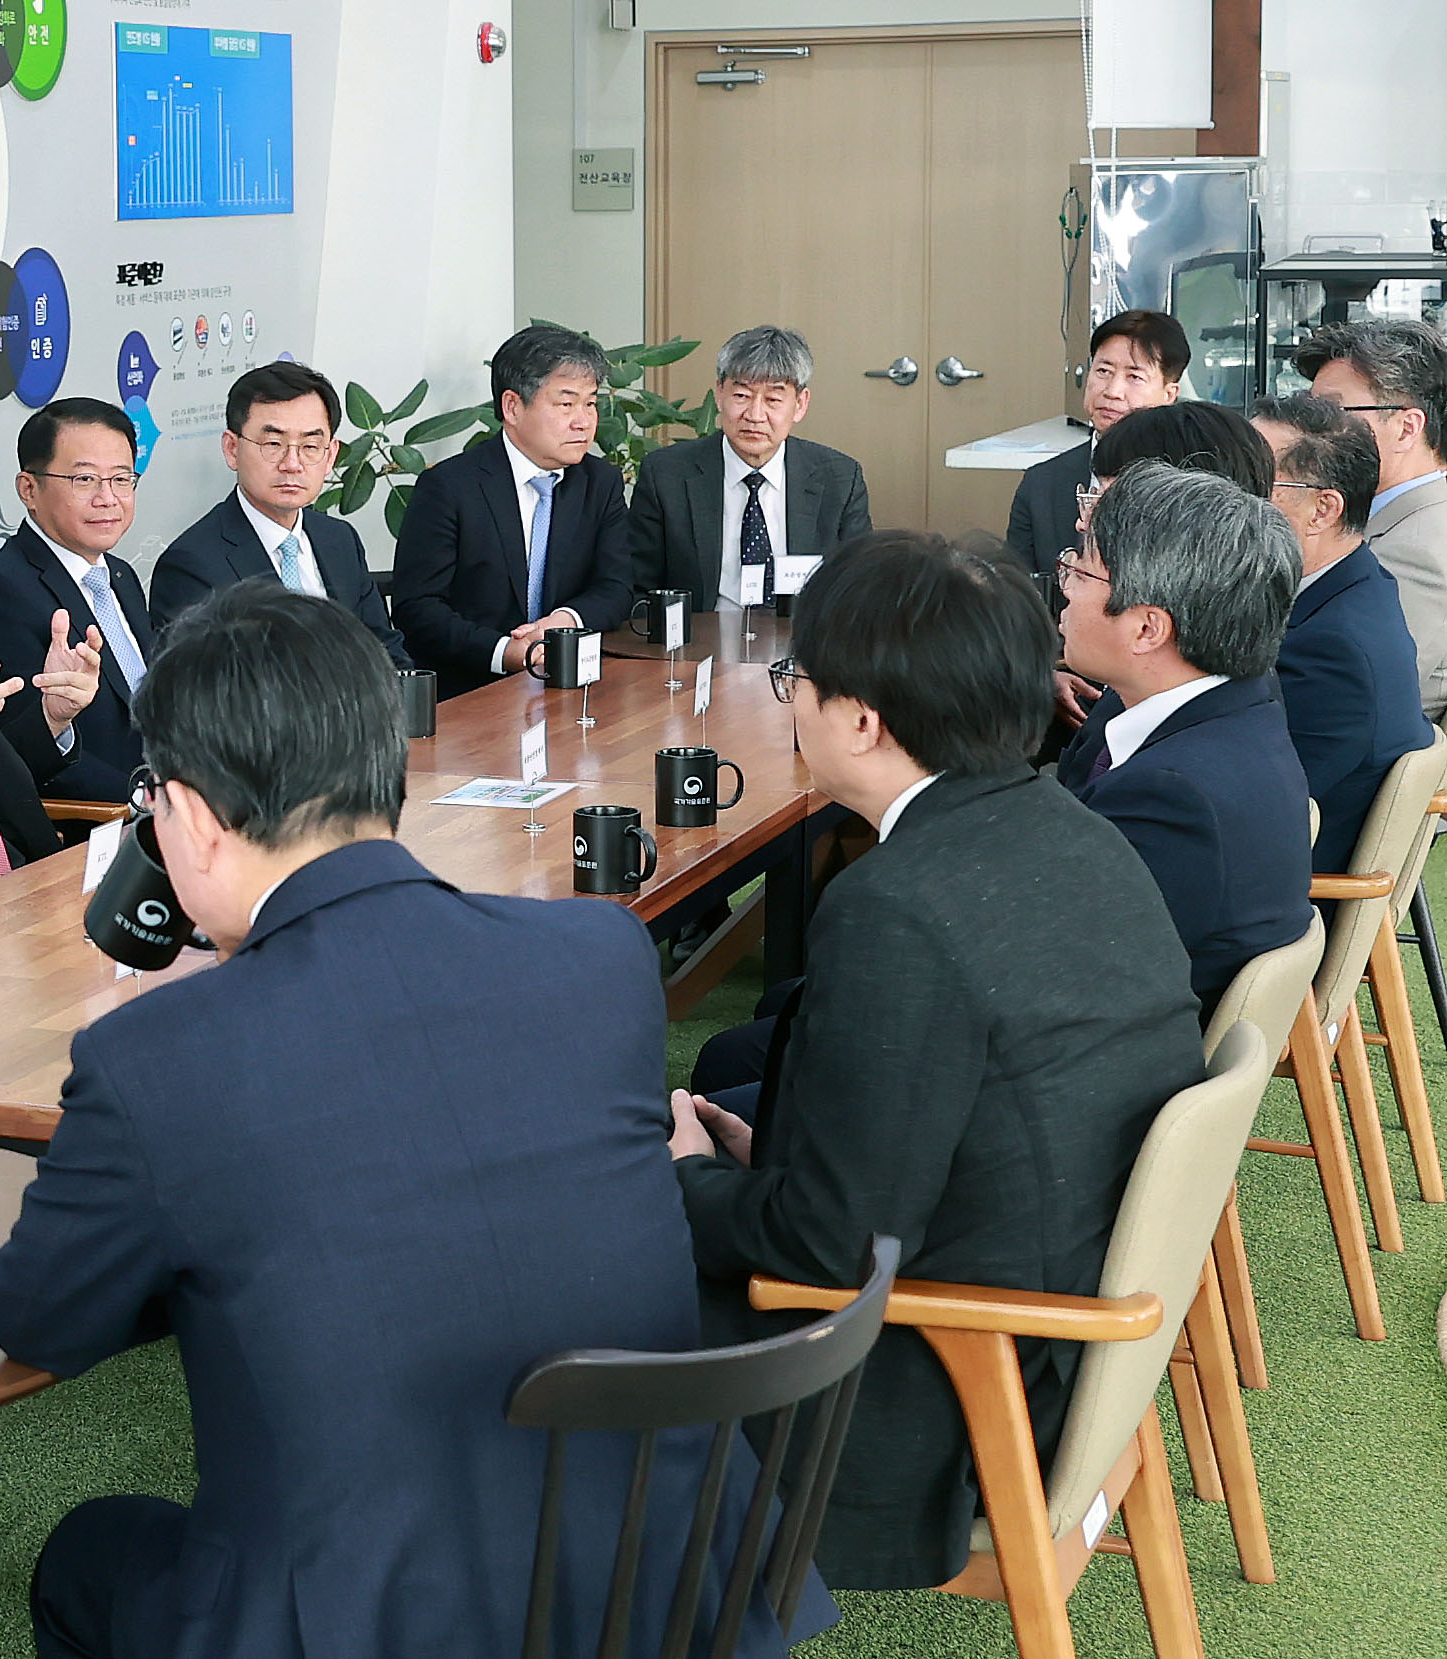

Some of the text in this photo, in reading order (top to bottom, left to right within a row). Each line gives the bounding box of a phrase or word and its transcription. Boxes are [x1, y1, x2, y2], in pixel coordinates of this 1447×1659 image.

[28, 24, 49, 45] 안전
[580, 154, 594, 164] 107
[31, 338, 52, 359] 인증
